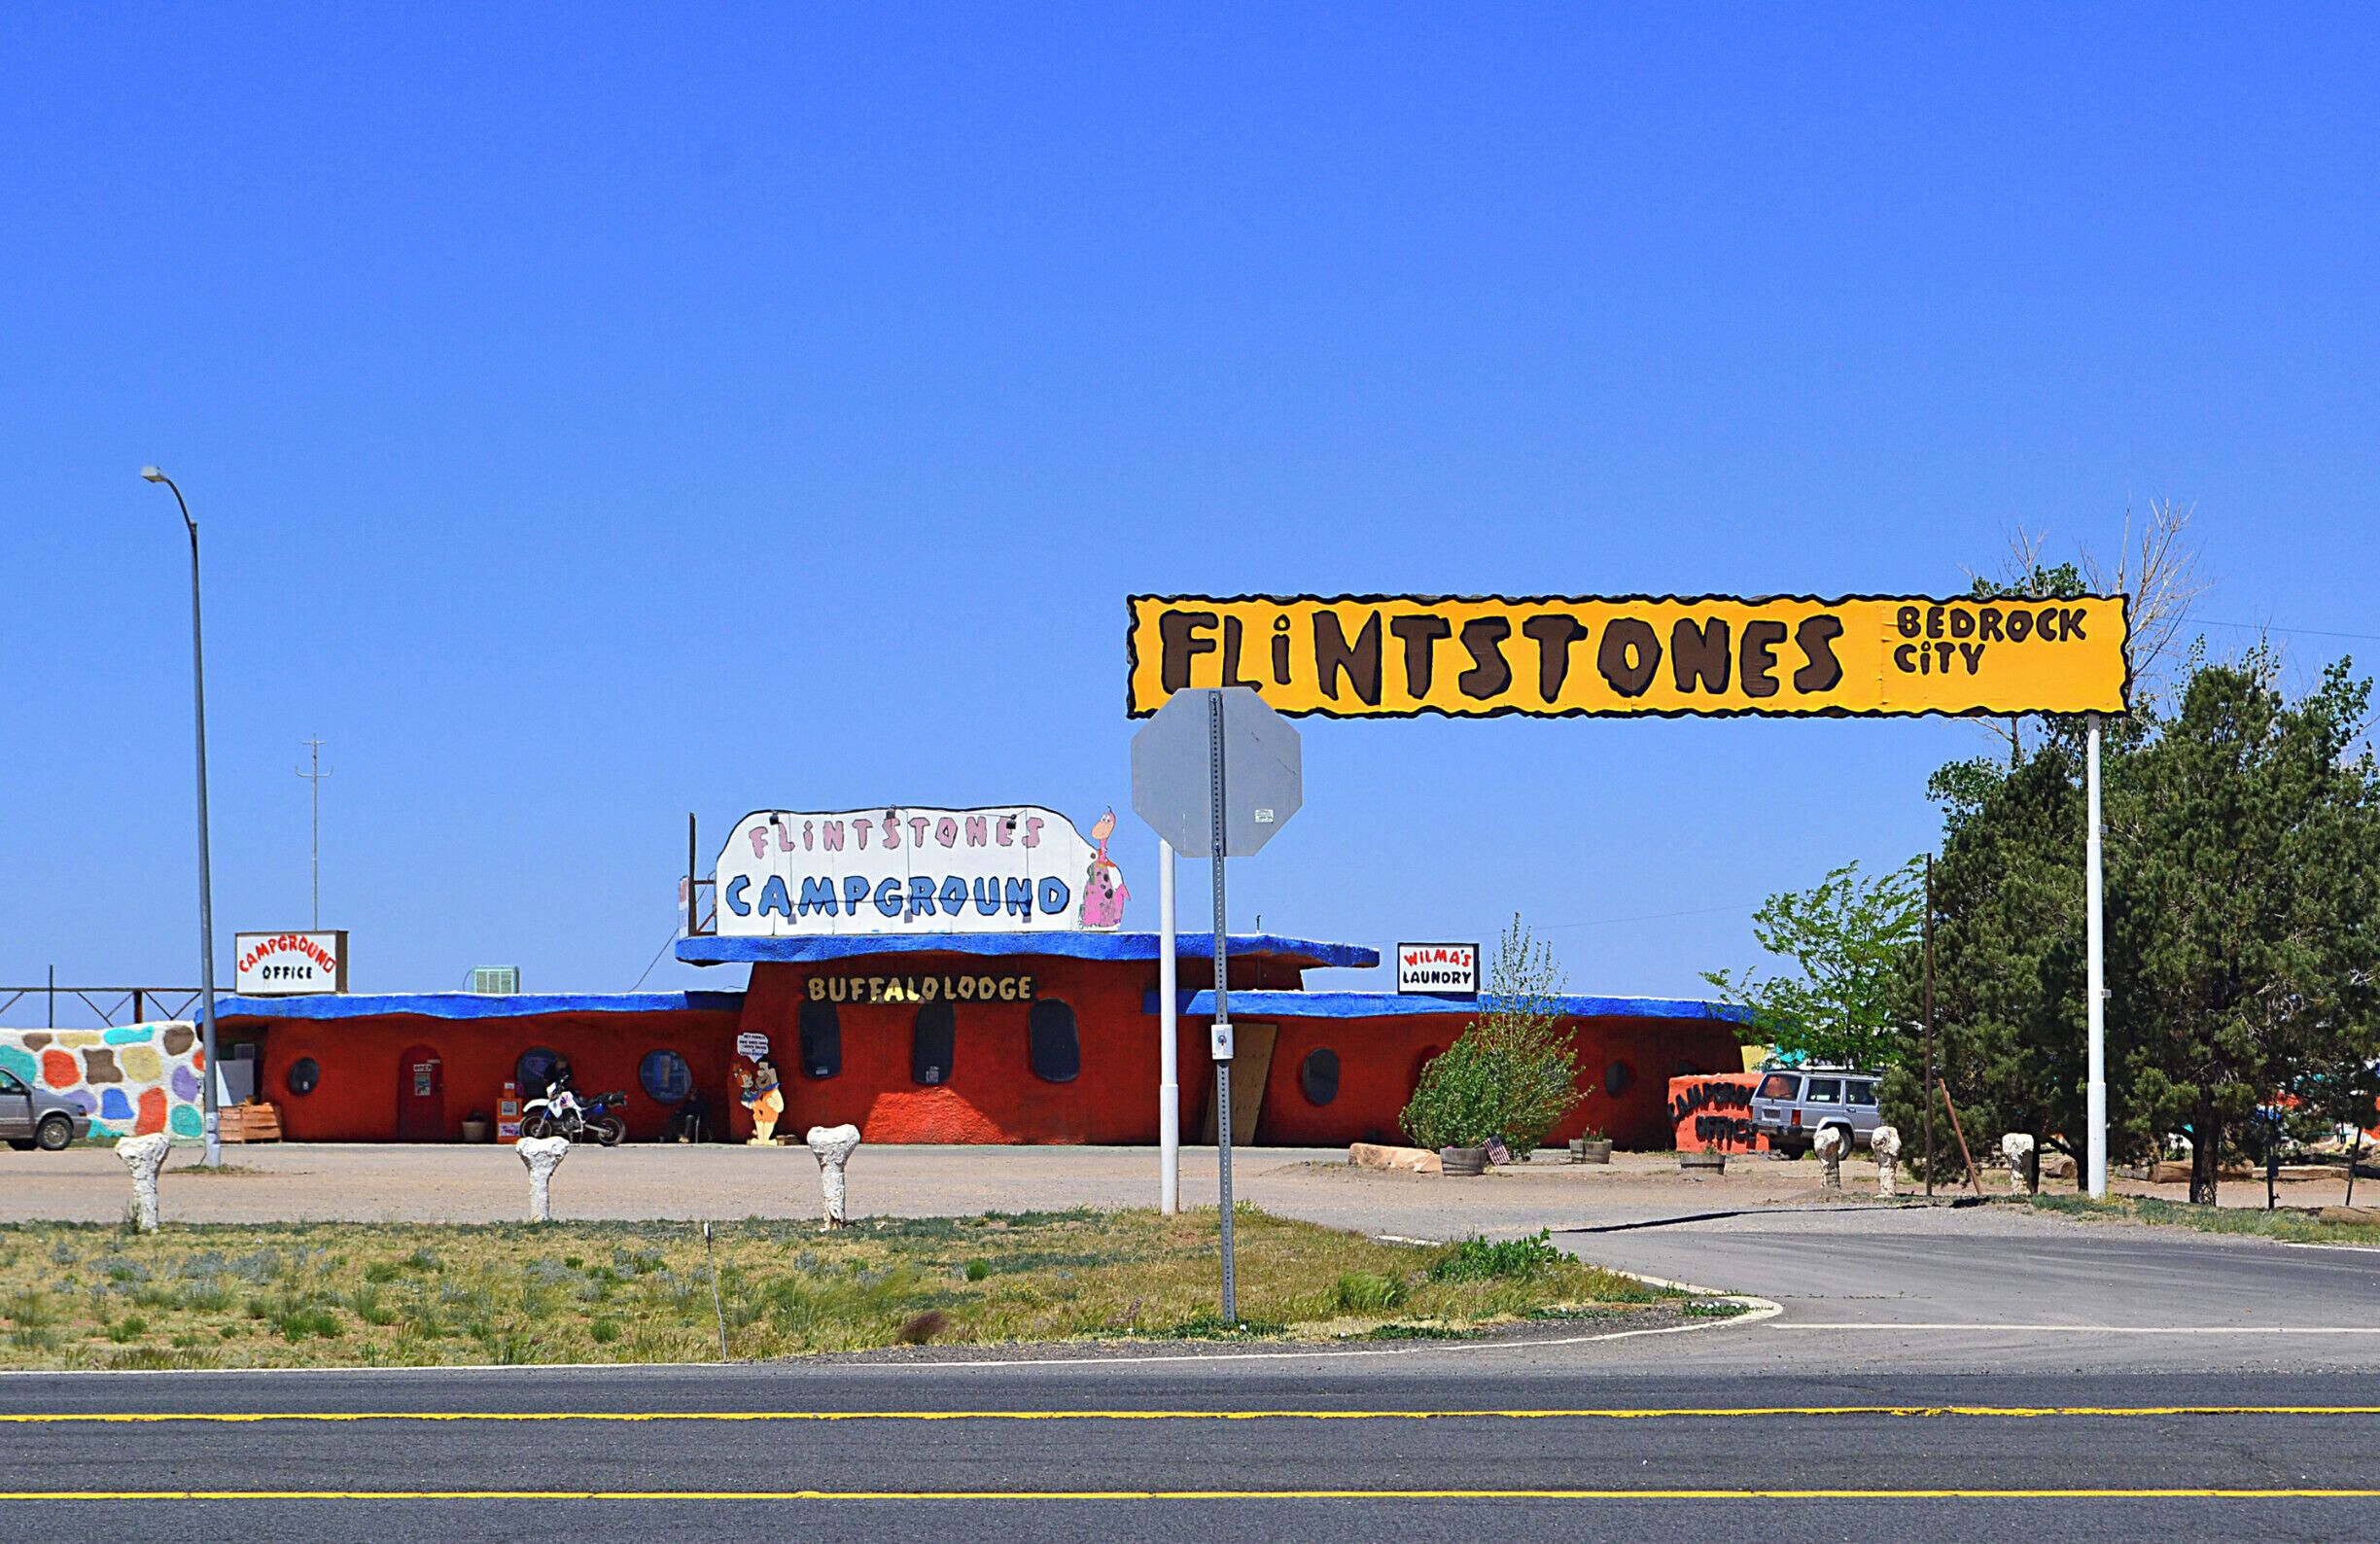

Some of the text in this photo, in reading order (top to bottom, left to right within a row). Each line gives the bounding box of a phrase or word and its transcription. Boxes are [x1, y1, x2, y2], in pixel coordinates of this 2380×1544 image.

[1897, 606, 2087, 643] BEDROCK
[725, 875, 1070, 917] CAMPGROUND
[239, 934, 336, 973] CAMPGROUND
[1404, 948, 1472, 967] WILMA'S
[808, 976, 1032, 1002] BUFFALO LODGE
[1403, 970, 1472, 985] LAUNDRY
